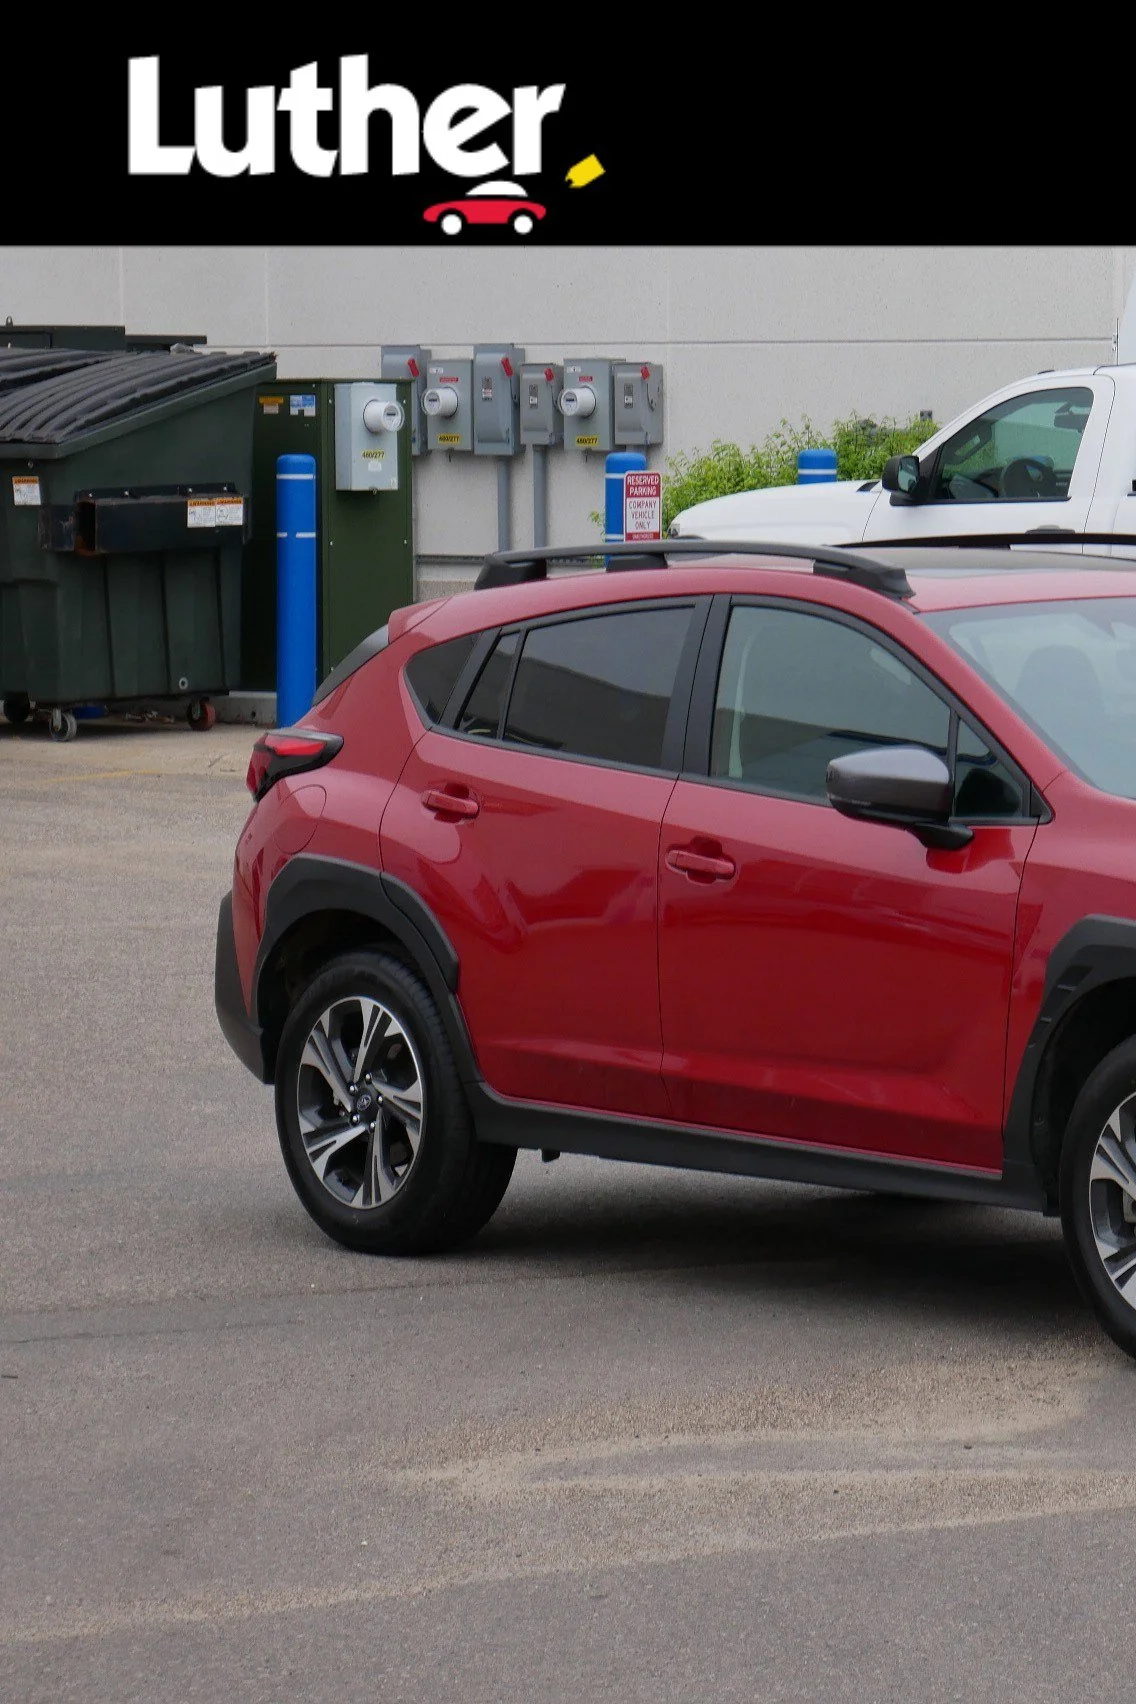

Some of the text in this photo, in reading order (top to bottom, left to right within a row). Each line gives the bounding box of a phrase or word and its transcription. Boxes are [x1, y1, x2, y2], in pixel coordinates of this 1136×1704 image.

[627, 475, 659, 486] RESERVED
[629, 486, 657, 496] PARKING
[628, 500, 657, 509] COMPANY
[631, 510, 655, 519] VEHICLE
[635, 520, 651, 529] ONLY
